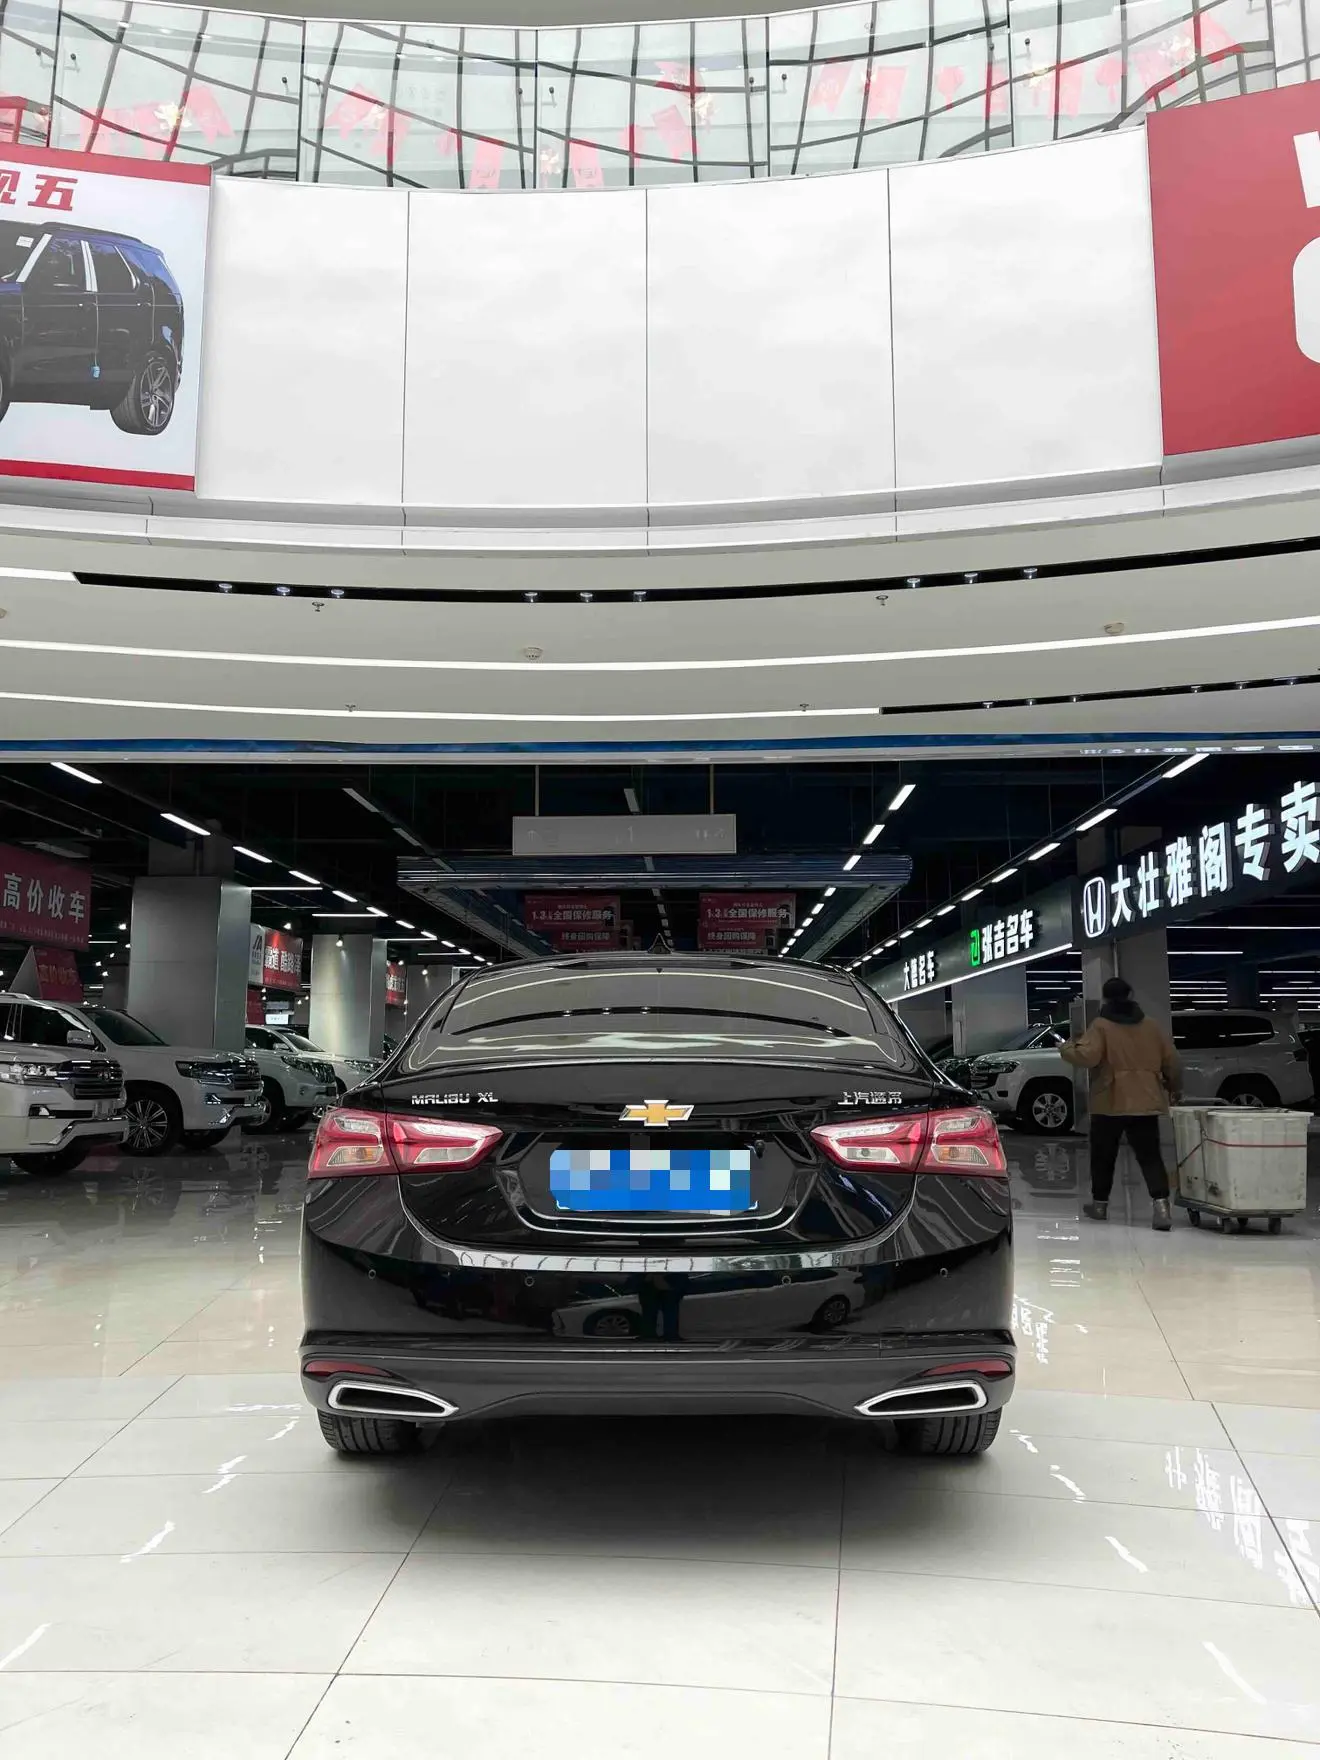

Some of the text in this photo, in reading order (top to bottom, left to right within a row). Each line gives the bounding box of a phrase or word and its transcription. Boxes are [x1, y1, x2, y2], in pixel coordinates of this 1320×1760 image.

[1111, 781, 1320, 927] 大壮雅阁专卖
[3, 872, 86, 924] 高价收车
[981, 908, 1034, 964] 张吉名车
[411, 1091, 499, 1105] MALIBU XL
[837, 1091, 902, 1105] 上汽通用
